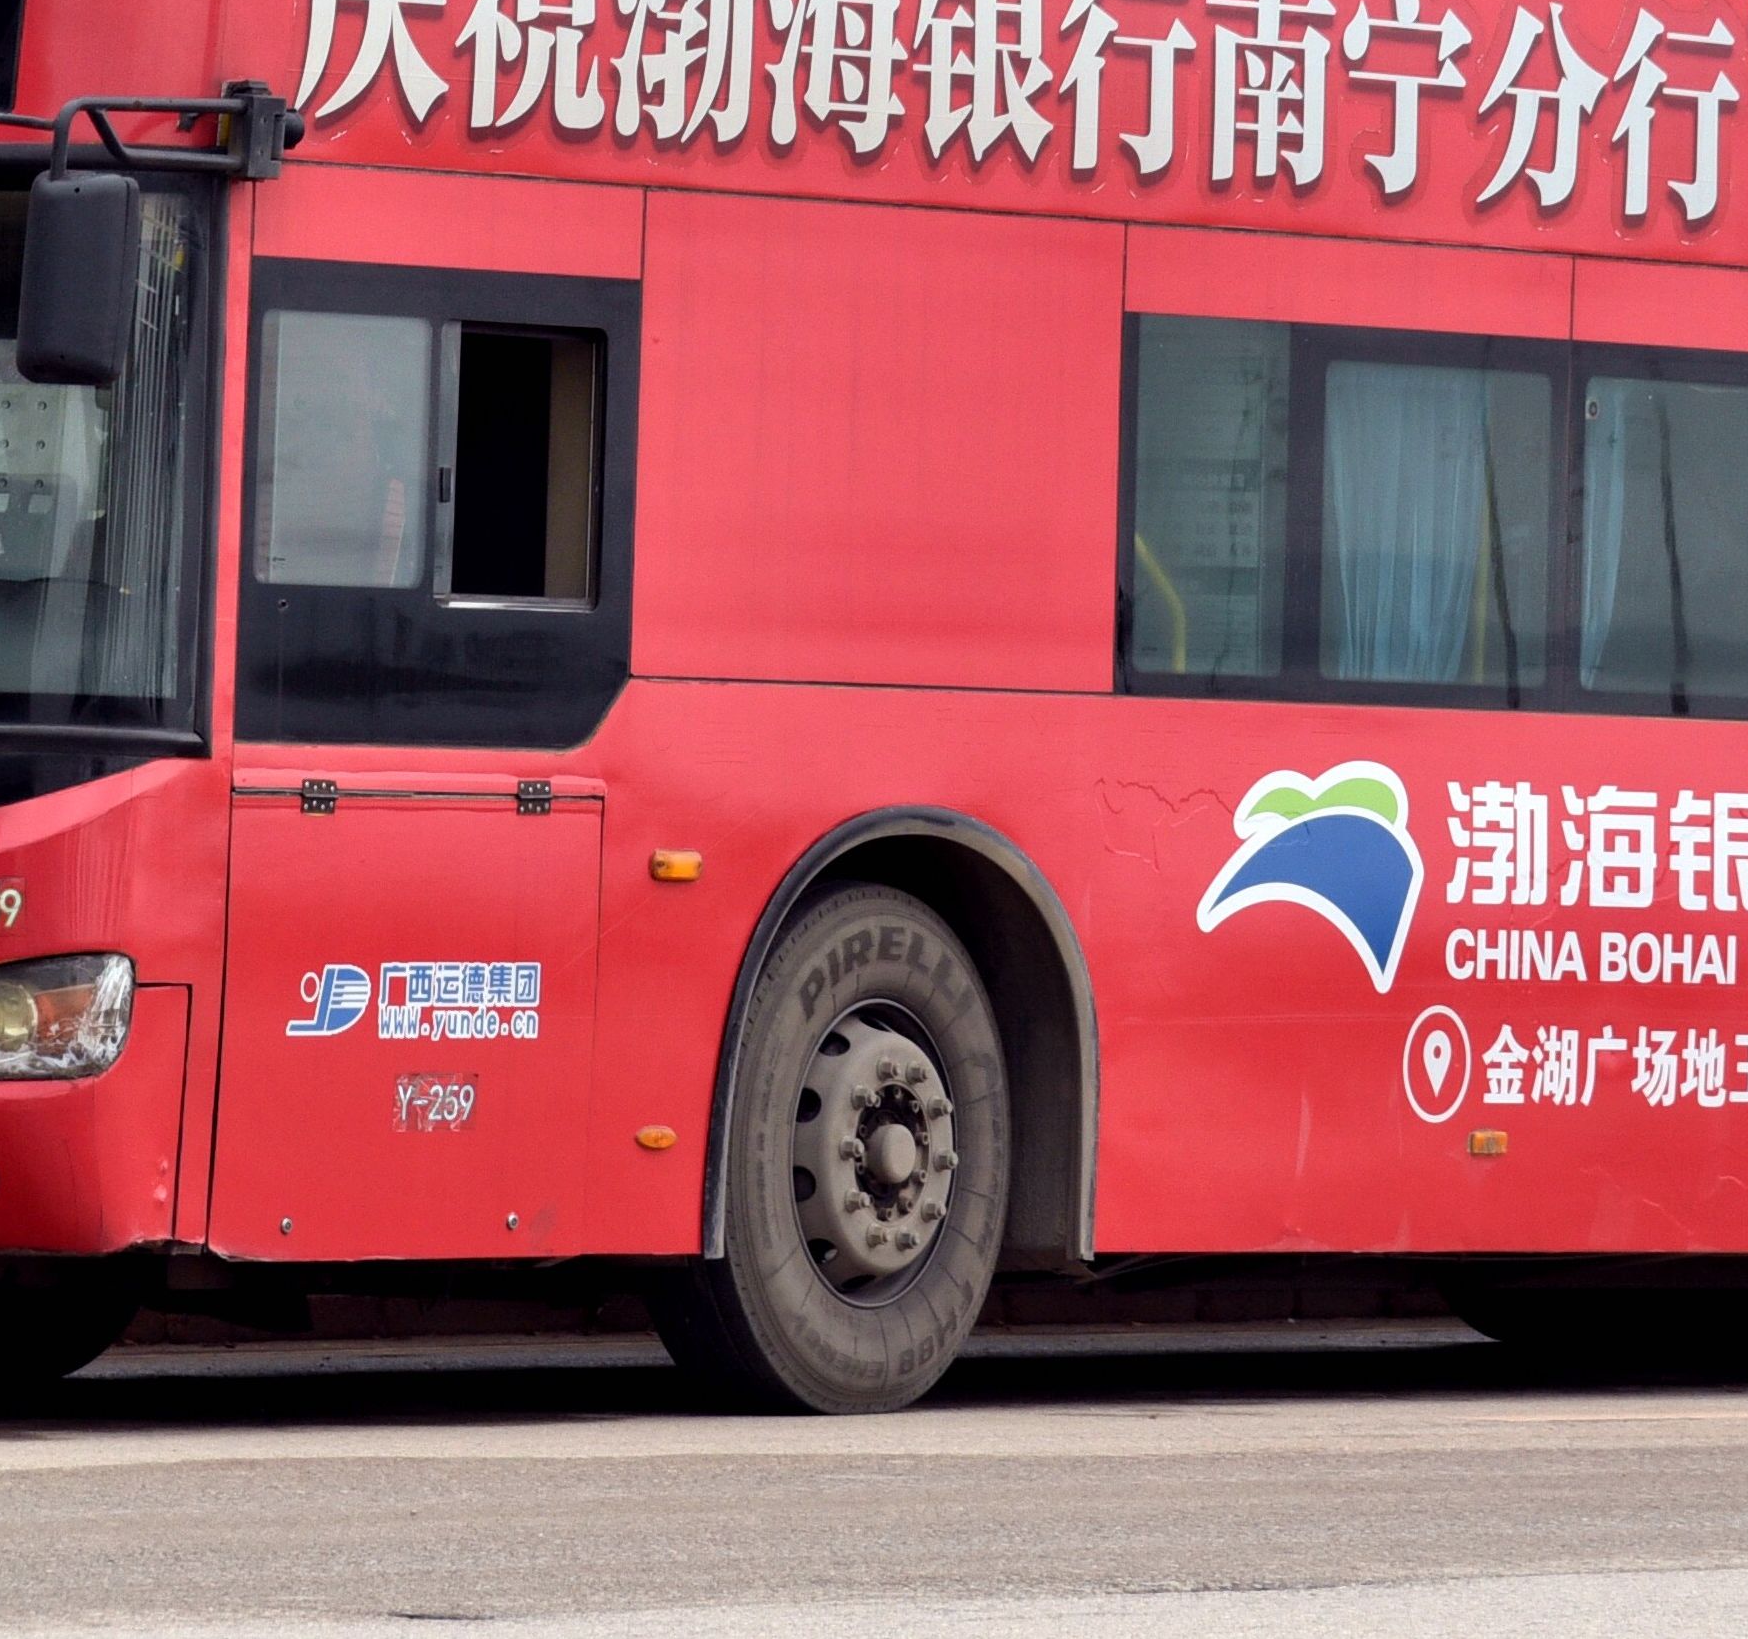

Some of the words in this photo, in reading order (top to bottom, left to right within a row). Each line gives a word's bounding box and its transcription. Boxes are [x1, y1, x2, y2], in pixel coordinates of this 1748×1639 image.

[1445, 928, 1588, 982] CHINA
[1599, 931, 1737, 985] BOHAI
[380, 963, 540, 1006] 广西运德集团
[398, 1084, 474, 1121] Y-259
